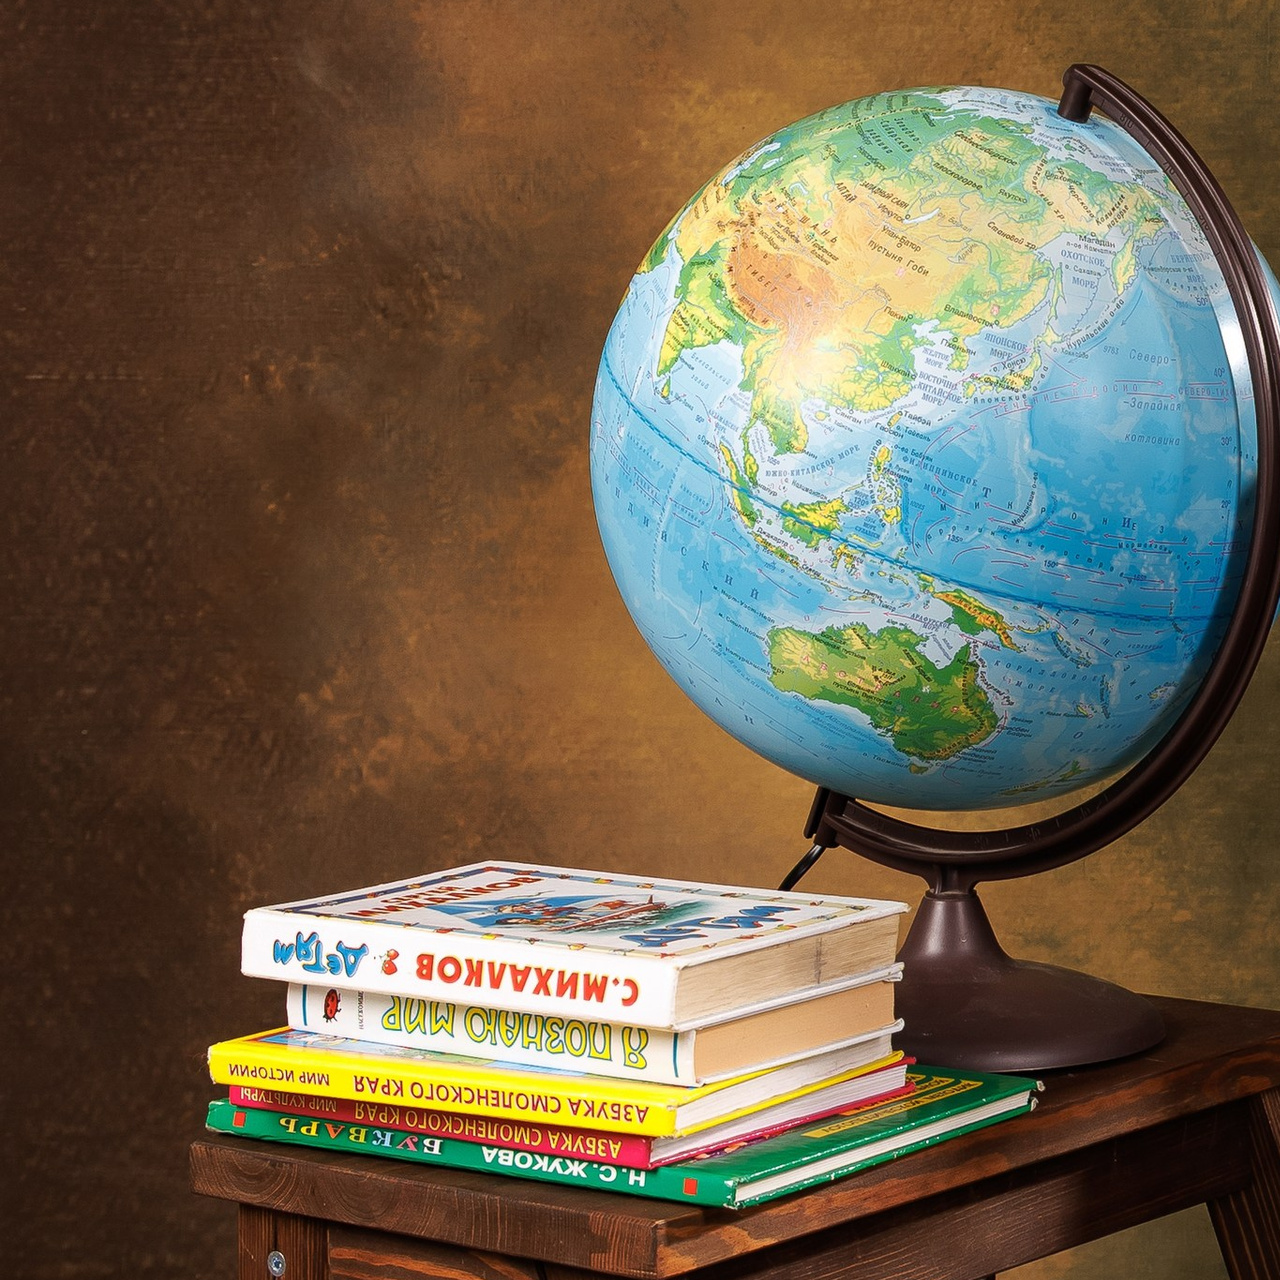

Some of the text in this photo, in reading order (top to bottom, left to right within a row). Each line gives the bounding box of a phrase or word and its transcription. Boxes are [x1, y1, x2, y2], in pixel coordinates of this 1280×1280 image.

[953, 129, 1018, 167] Среднесибирское
[932, 162, 983, 191] плоскогорье
[835, 181, 858, 204] АЛТАЙ
[859, 181, 911, 210] ЗАПАДНЫЙ САЯН
[880, 224, 923, 254] Улан-Батор
[986, 220, 1025, 245] Становой
[868, 239, 931, 278] пустыня Гоби
[1060, 248, 1107, 269] ОХОТСКОЕ
[745, 263, 778, 293] ТИБЕТ
[1071, 276, 1098, 290] МОРЕ
[943, 303, 996, 330] Владивосток
[984, 332, 1029, 352] ЯПОНСКОЕ
[1129, 349, 1178, 368] Северо-
[837, 443, 862, 461] МОРЕ
[1123, 432, 1182, 447] котловина
[923, 482, 949, 498] МОРЕ
[345, 877, 546, 918] МИХАЛКОВ
[381, 994, 650, 1069] Я ПОЗНАЮ МИР
[228, 1062, 331, 1087] МИР ИСТОРИИ
[239, 1086, 338, 1113] МИР КУЛЬТУРЫ
[353, 1074, 649, 1122] АЗБУКА СМОЛЕНСКОГО КРАЯ
[278, 1114, 443, 1156] БУКВАРЬ
[354, 1101, 623, 1159] АЗБУКА СМОЛЕНСКОГО КРАЯ
